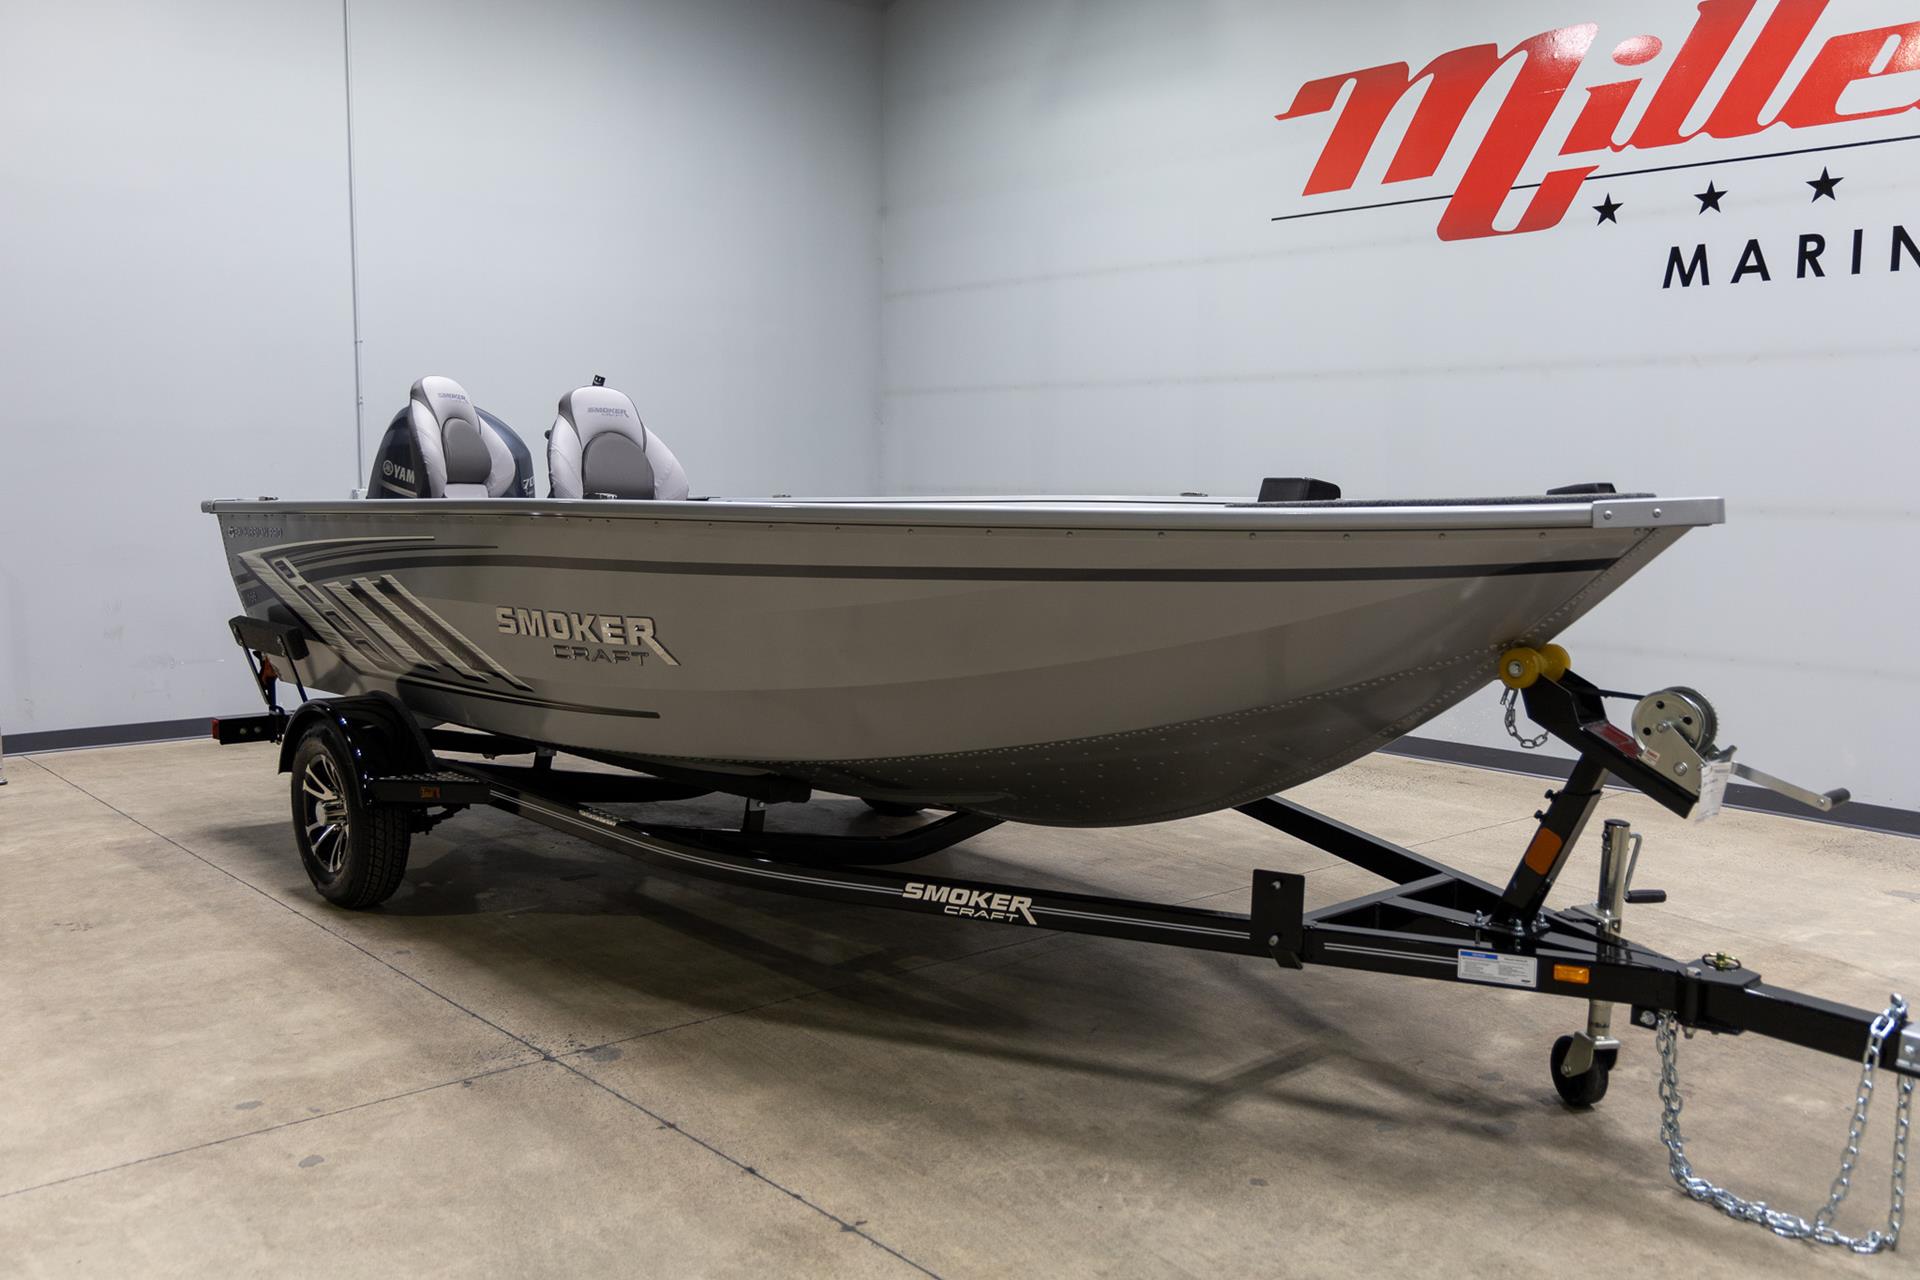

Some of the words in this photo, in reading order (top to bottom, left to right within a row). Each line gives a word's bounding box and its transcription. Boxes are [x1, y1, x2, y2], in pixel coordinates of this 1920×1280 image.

[587, 407, 629, 418] SMOKER
[495, 605, 681, 666] SMOKER
[553, 644, 649, 666] CRAFT
[902, 882, 1037, 925] SMOKER
[944, 905, 1019, 922] CRAFT
